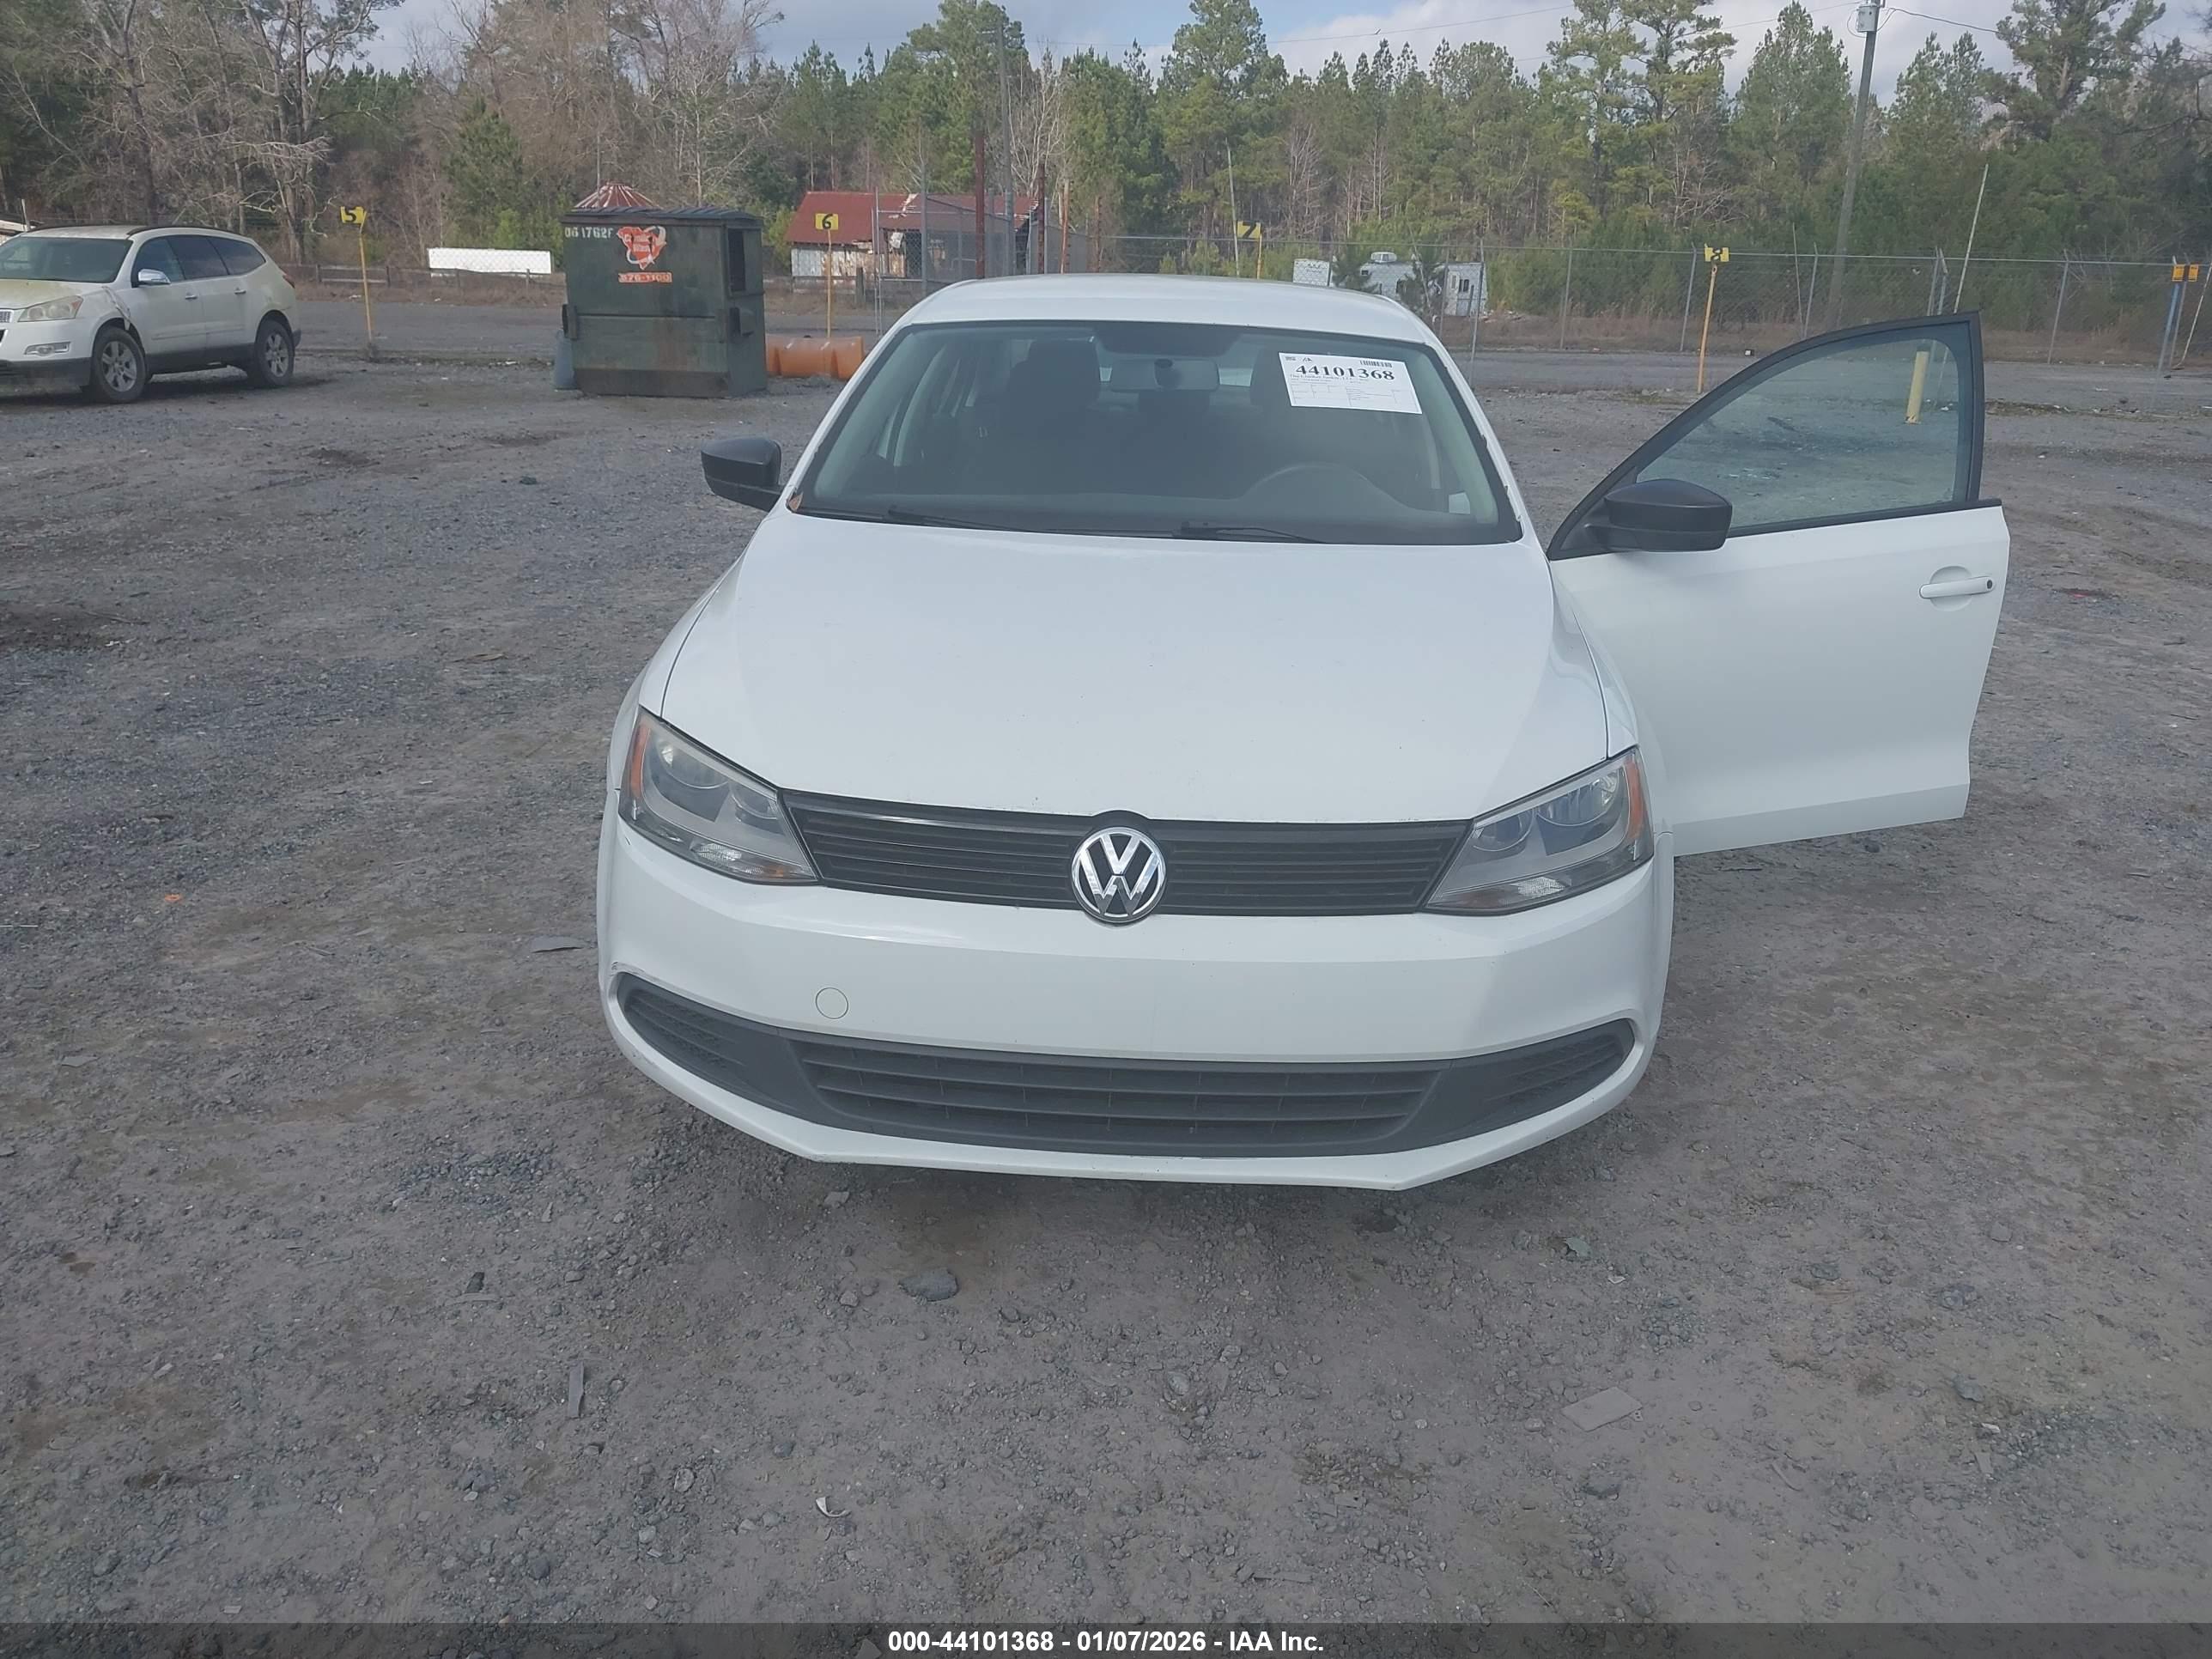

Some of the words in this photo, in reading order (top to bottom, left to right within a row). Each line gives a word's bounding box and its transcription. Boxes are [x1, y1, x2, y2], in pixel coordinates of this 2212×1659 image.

[343, 205, 357, 222] 5
[822, 213, 834, 230] 6
[1242, 220, 1258, 238] 7
[1295, 365, 1395, 380] 44101368
